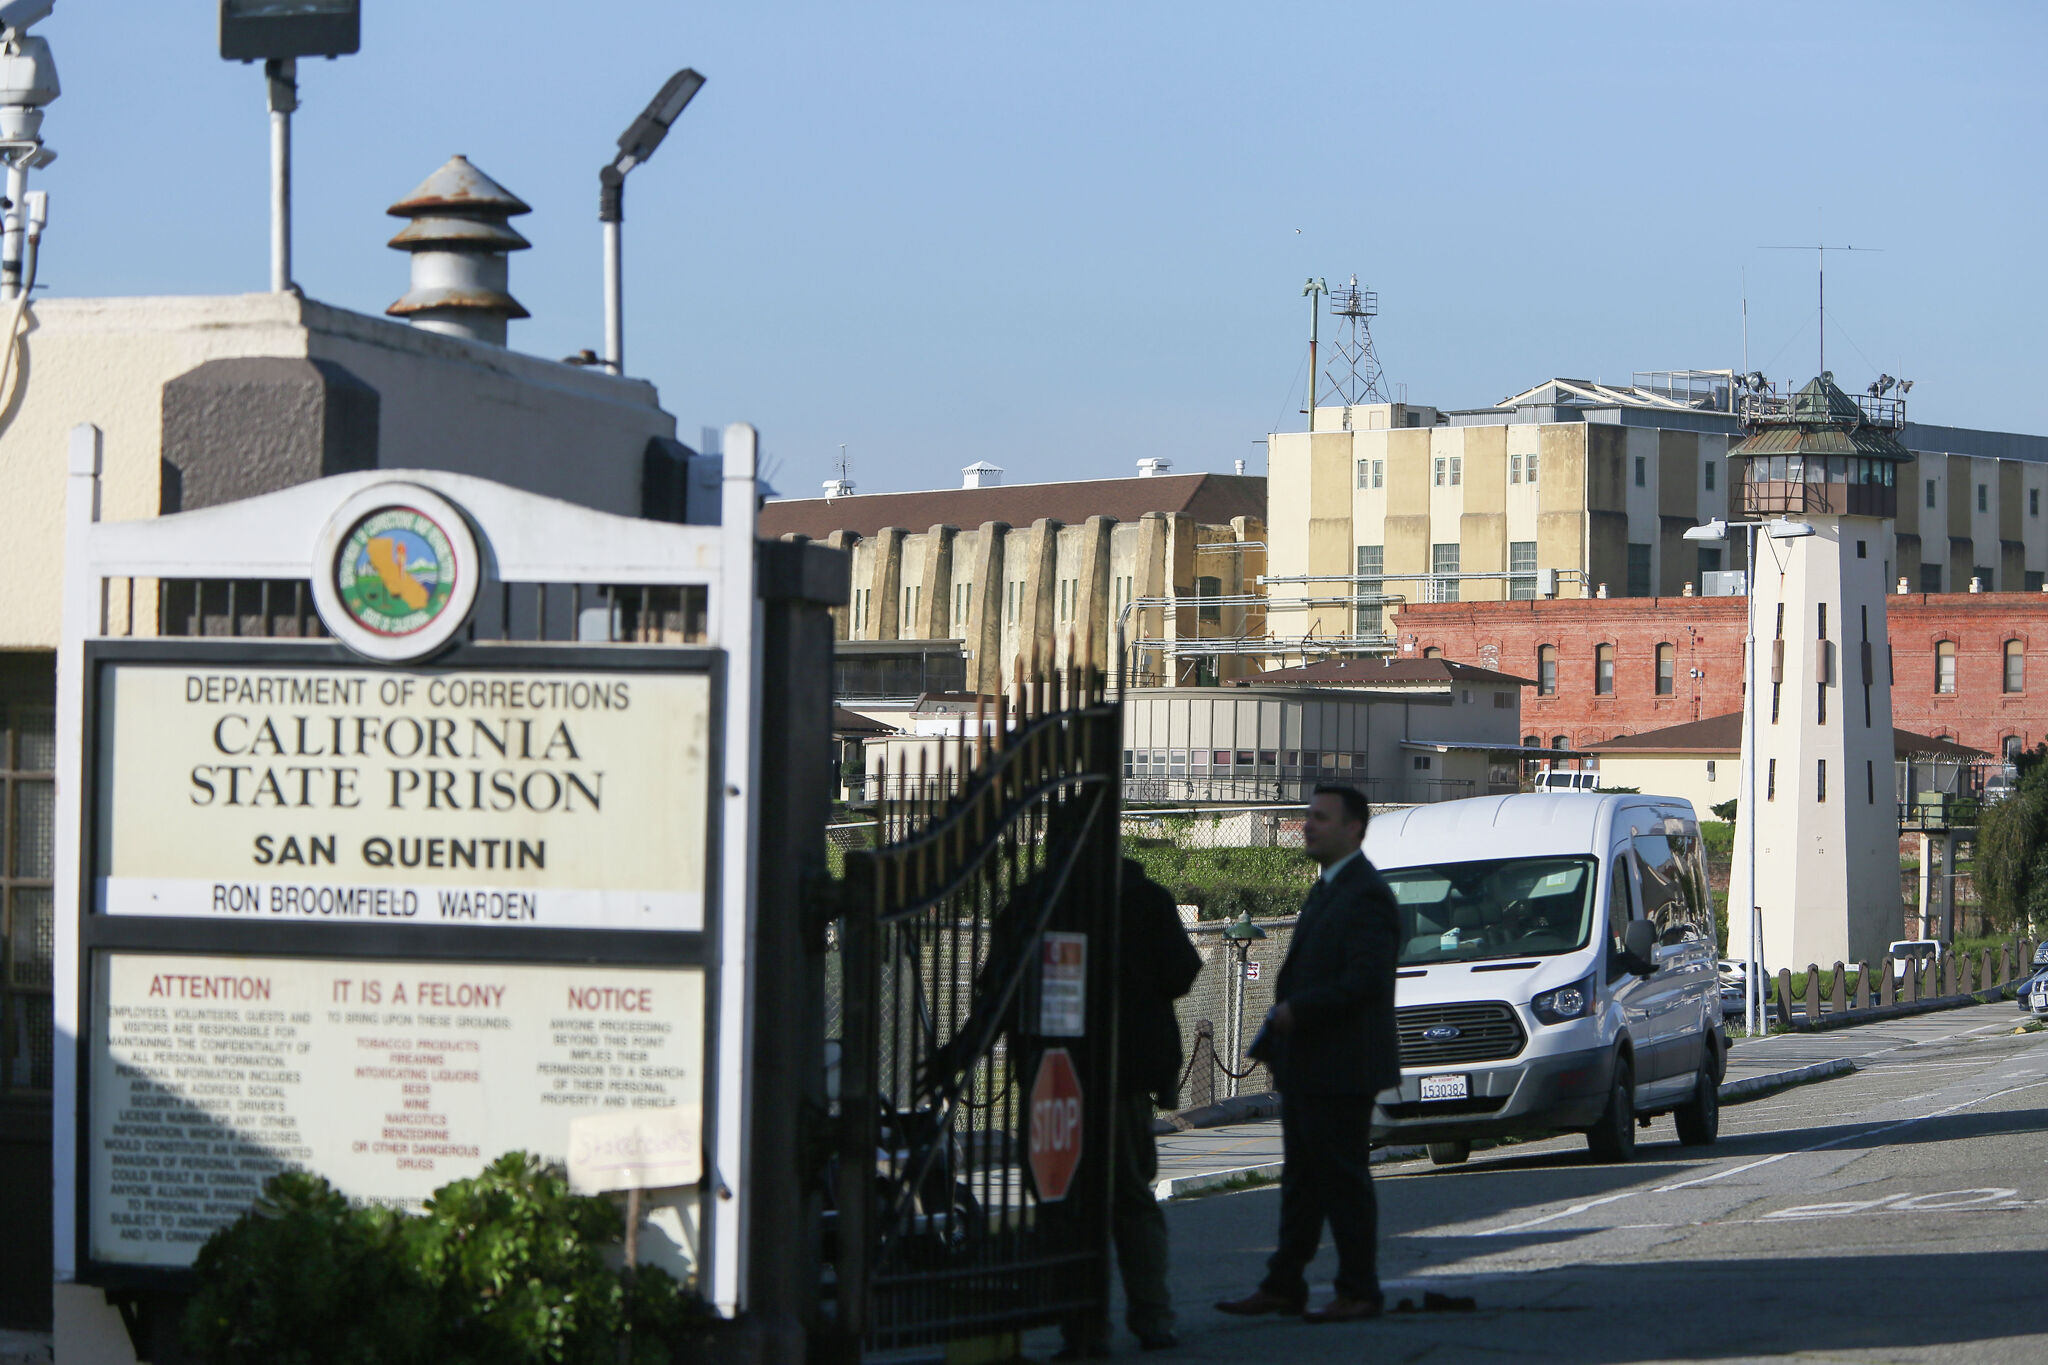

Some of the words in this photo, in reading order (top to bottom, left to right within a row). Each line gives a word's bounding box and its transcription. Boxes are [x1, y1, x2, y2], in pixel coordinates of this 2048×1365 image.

[186, 675, 367, 707] DEPARTMENT
[380, 679, 415, 707] OF
[428, 679, 631, 711] CORRECTIONS
[212, 713, 582, 761] CALIFORNIA
[189, 765, 361, 808] STATE
[387, 769, 606, 813] PRISON
[253, 834, 338, 866] SAN
[362, 838, 547, 870] QUENTIN
[212, 884, 259, 914] RON
[271, 885, 418, 918] BROOMFIELD
[438, 891, 536, 920] WARDEN
[149, 974, 271, 1001] ATTENTION
[333, 979, 352, 1002] IT
[363, 980, 382, 1004] IS
[392, 981, 408, 1004] A
[418, 982, 506, 1008] FELONY
[568, 986, 653, 1013] NOTICE
[290, 1012, 311, 1024] AND
[328, 1011, 341, 1023] TO
[173, 1023, 193, 1034] ARE
[275, 1026, 296, 1038] FOR
[177, 1038, 196, 1049] THE
[297, 1042, 311, 1054] OF
[356, 1037, 412, 1050] TOBACCO
[416, 1038, 481, 1052] PRODUCTS
[553, 1033, 599, 1046] BEYOND
[604, 1034, 627, 1047] THIS
[631, 1035, 664, 1047] POINT
[131, 1052, 149, 1063] ALL
[153, 1053, 207, 1065] PERSONAL
[389, 1053, 445, 1066] FIREARMS
[609, 1064, 623, 1076] TO
[553, 1078, 568, 1090] OF
[608, 1080, 666, 1093] PERSONAL
[1423, 1083, 1465, 1098] 1530382
[403, 1099, 430, 1110] WINE
[603, 1094, 626, 1107] AND
[385, 1113, 447, 1126] NARCOTICS
[1032, 1097, 1078, 1152] STOP
[104, 1139, 141, 1151] WOULD
[352, 1140, 368, 1153] OR
[372, 1141, 409, 1155] OTHER
[412, 1143, 481, 1158] DANGEROUS
[163, 1156, 177, 1168] OF
[127, 1199, 142, 1211] TO
[161, 1215, 174, 1227] TO
[120, 1228, 142, 1241] AND
